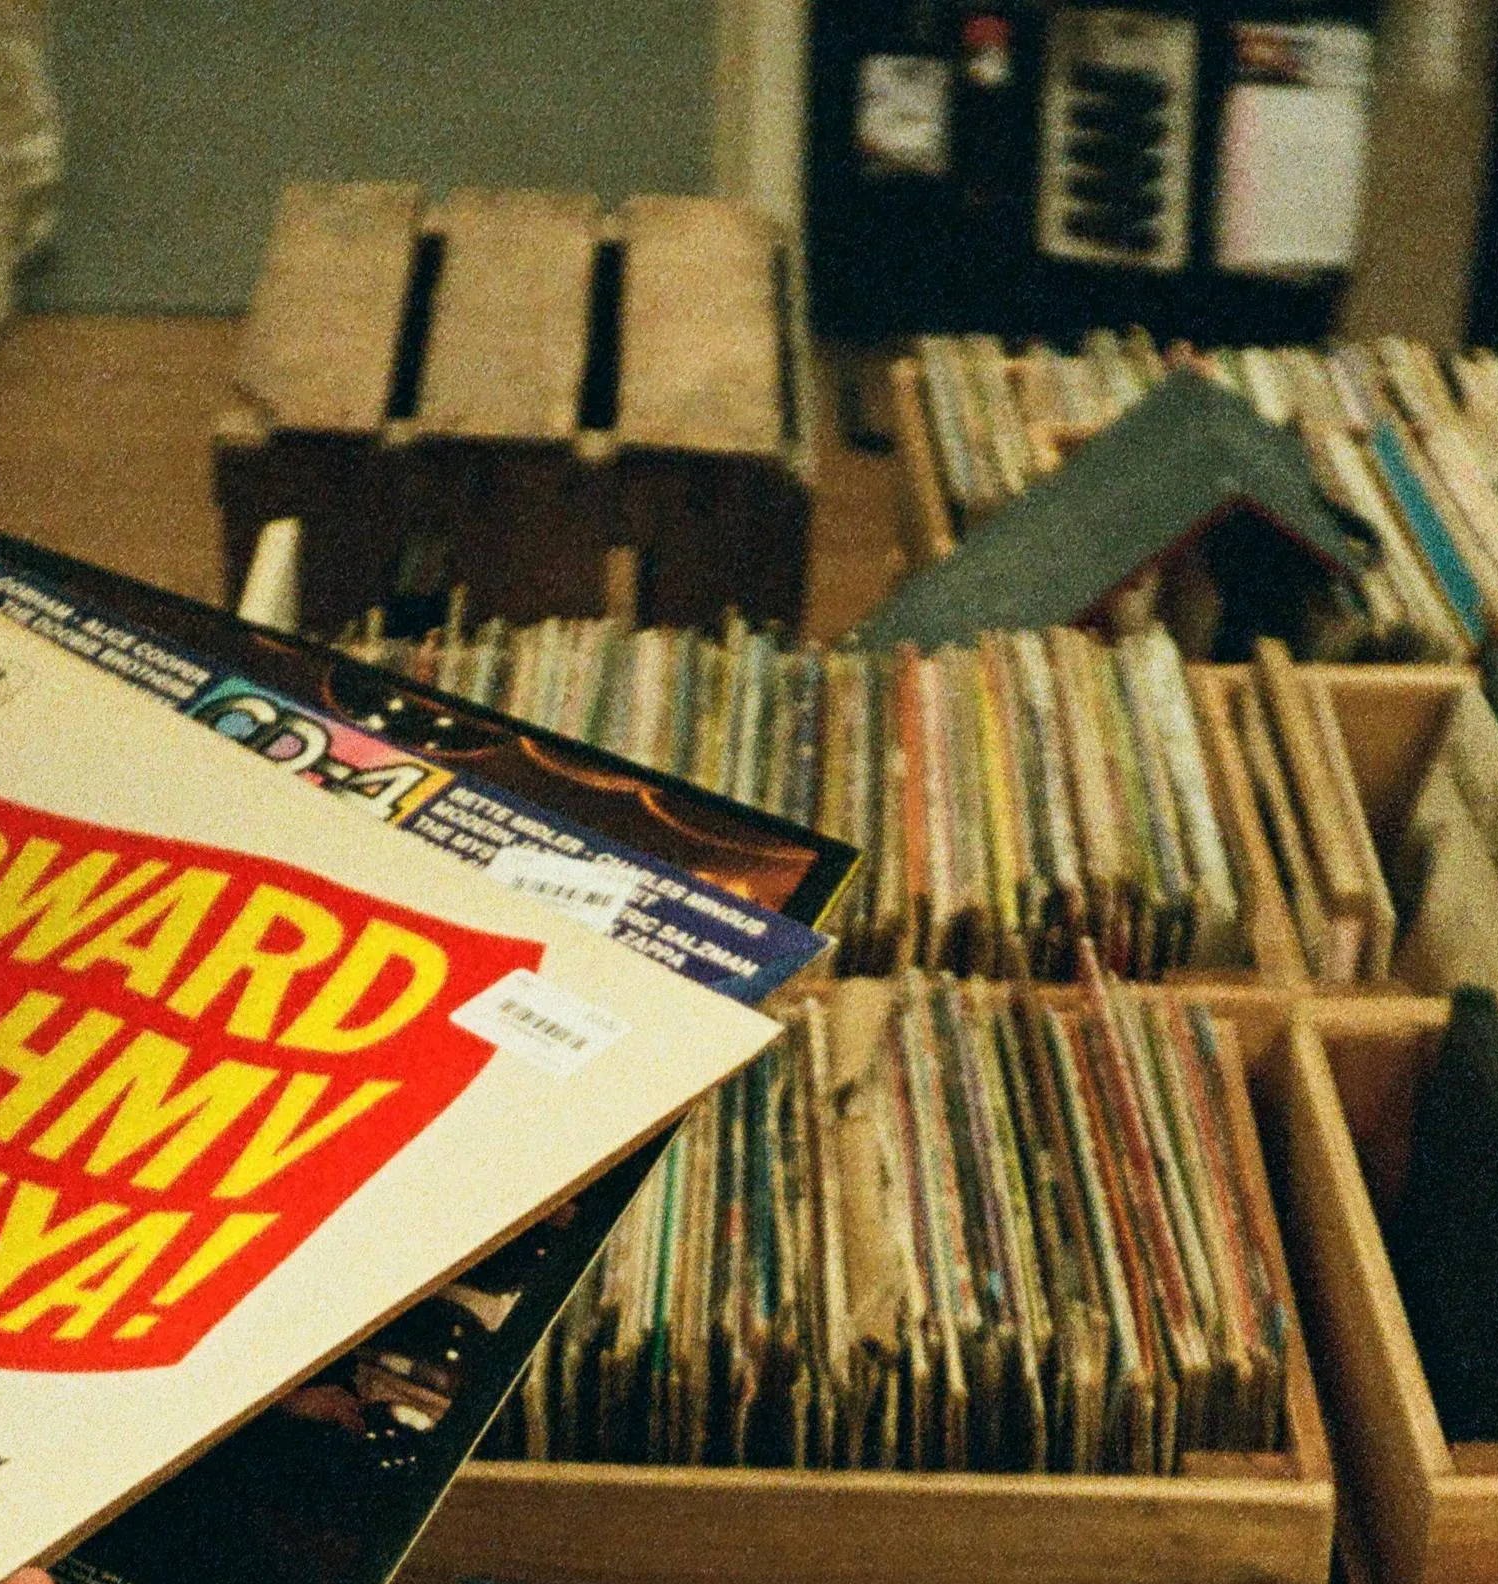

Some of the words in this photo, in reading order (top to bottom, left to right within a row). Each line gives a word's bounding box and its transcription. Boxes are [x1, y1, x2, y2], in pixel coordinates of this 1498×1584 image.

[201, 696, 433, 824] CD-4
[413, 813, 454, 842] THE
[429, 799, 517, 846] MODERN
[683, 891, 769, 937] MINGUS
